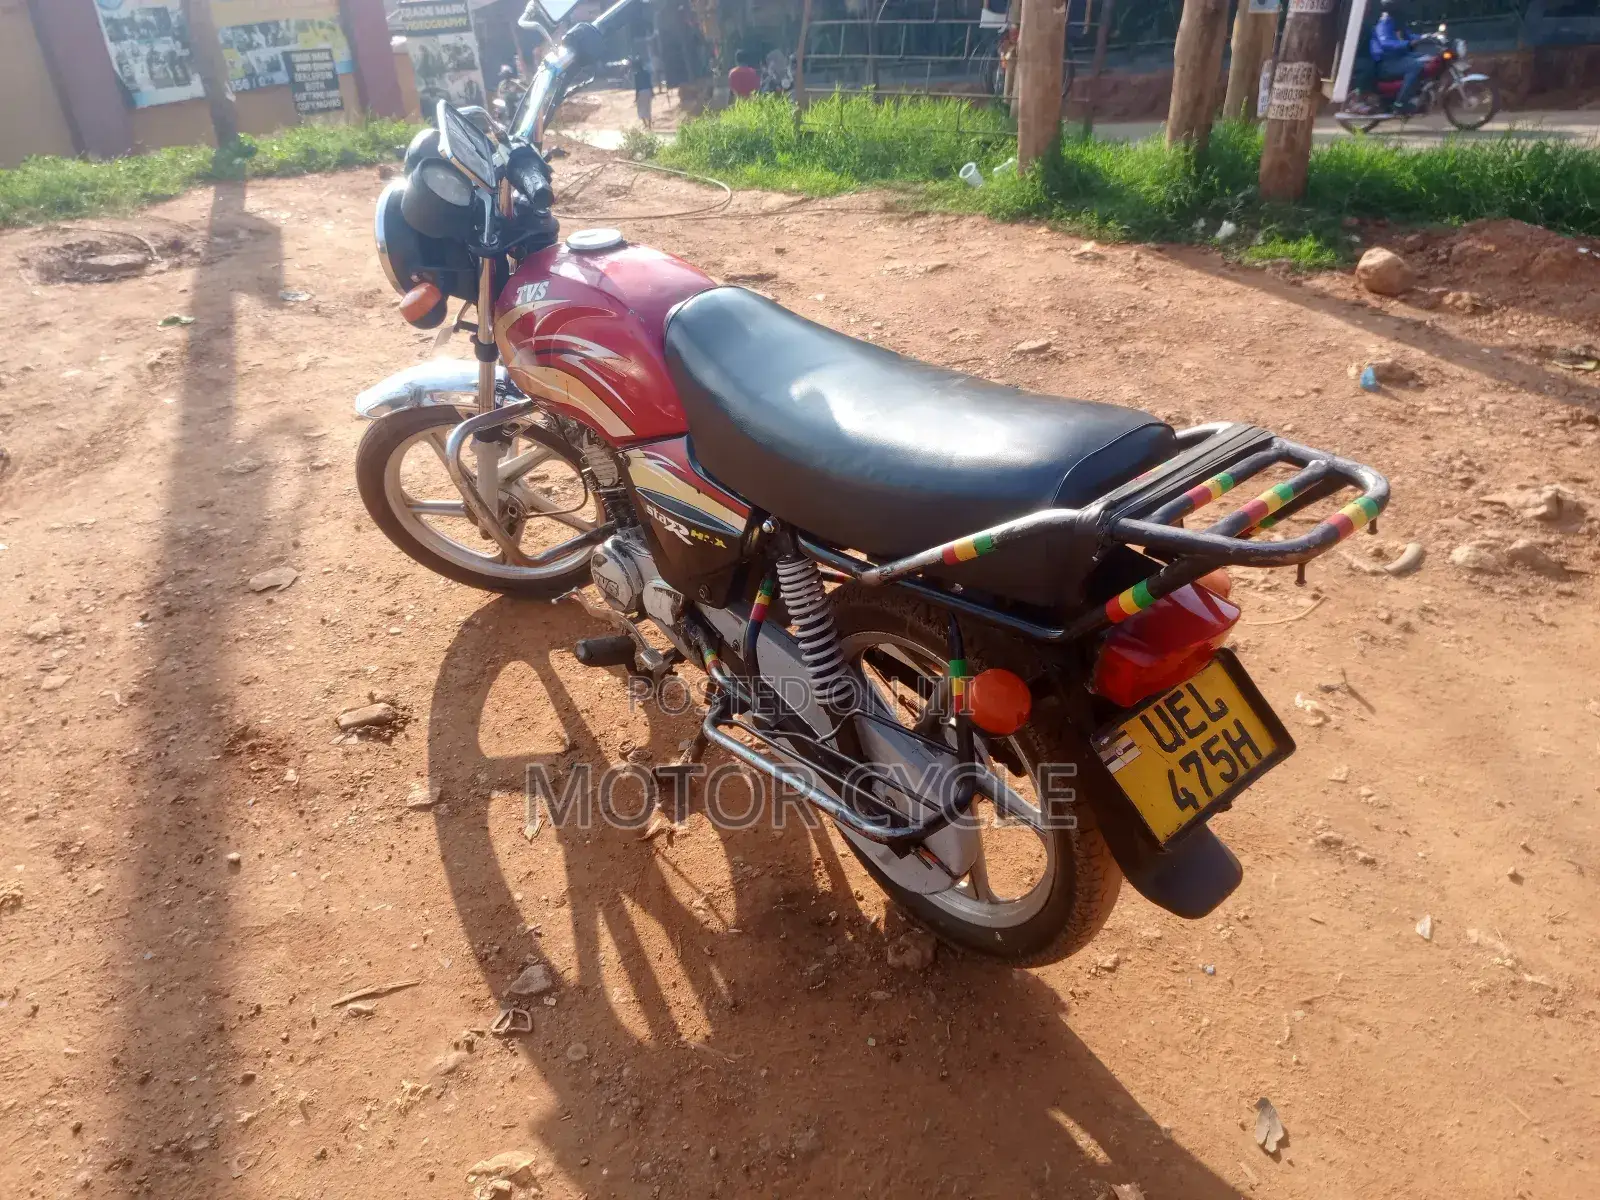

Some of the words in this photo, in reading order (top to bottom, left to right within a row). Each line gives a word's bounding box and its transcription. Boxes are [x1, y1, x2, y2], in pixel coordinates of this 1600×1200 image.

[515, 280, 550, 306] TVS
[1139, 682, 1230, 753] UEL
[1167, 718, 1263, 812] 475H
